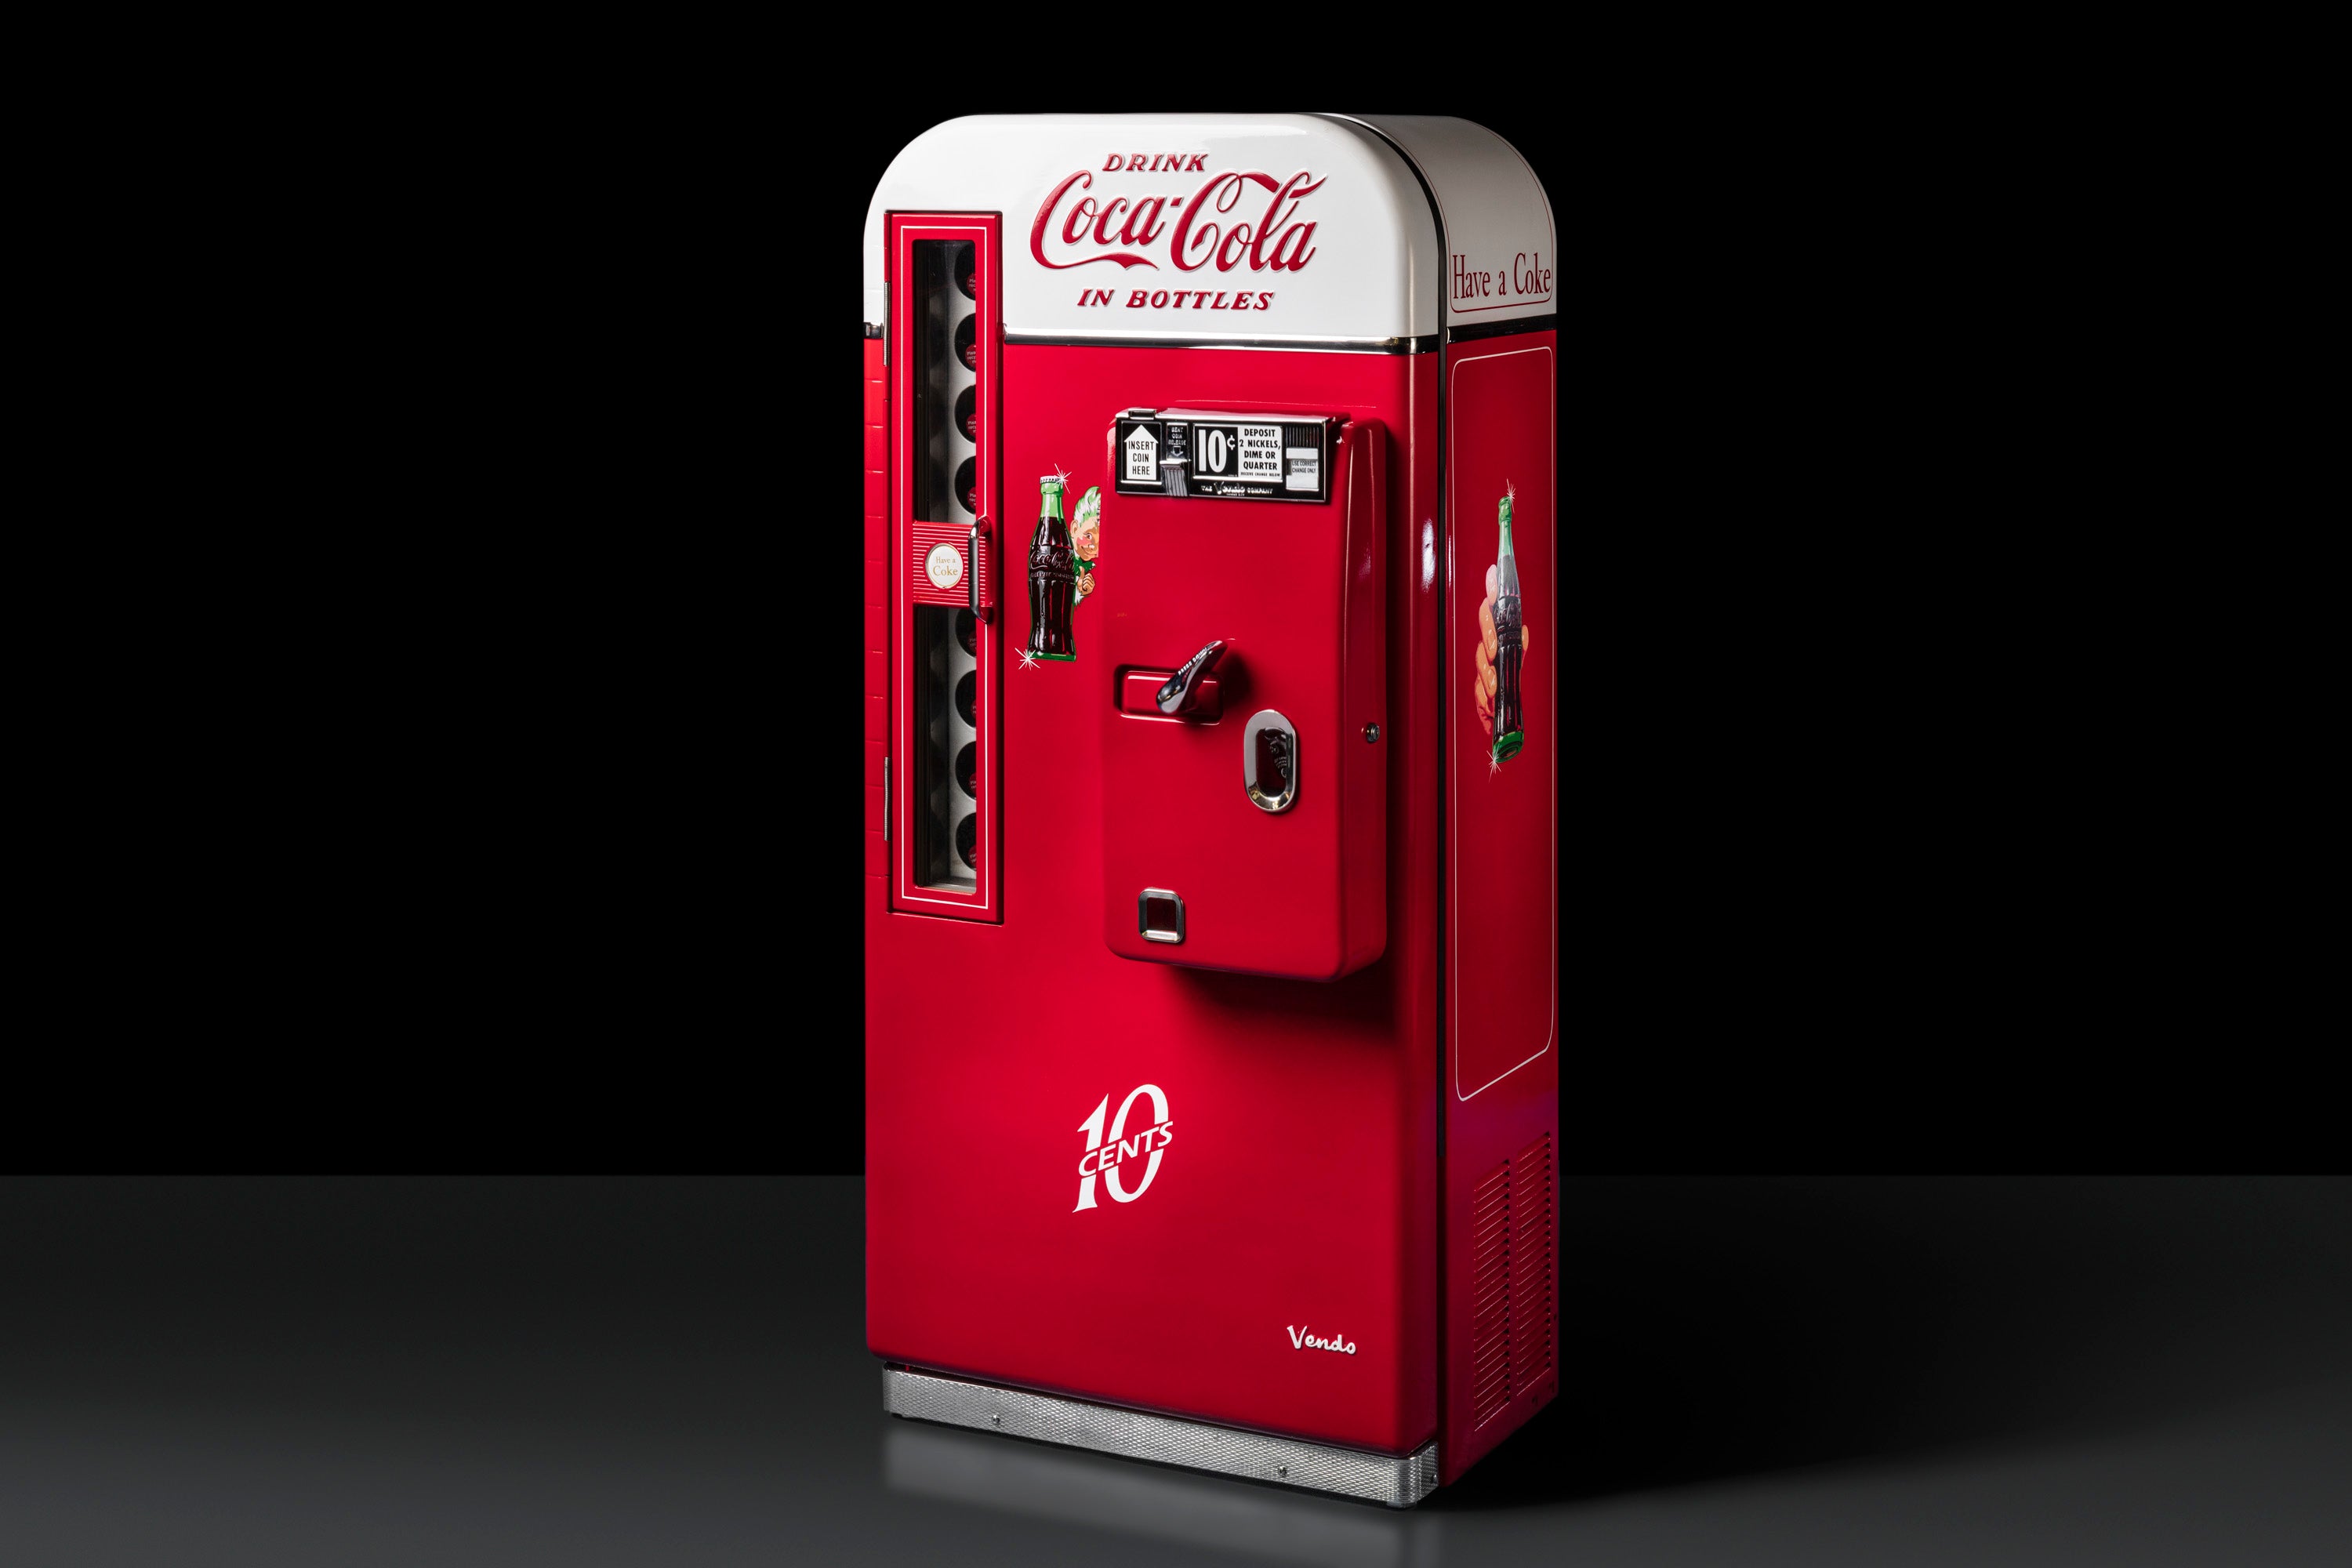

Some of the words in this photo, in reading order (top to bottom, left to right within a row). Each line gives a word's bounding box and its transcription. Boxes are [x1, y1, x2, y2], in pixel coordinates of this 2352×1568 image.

[1102, 153, 1208, 172] DRINK
[1030, 169, 1327, 271] Coca-Cola
[1453, 255, 1490, 299] Have
[1498, 270, 1507, 296] a
[1514, 252, 1551, 295] Coke
[1077, 289, 1115, 307] IN
[1126, 289, 1274, 311] BOTTLES
[1244, 428, 1276, 437] DEPOSIT
[1128, 441, 1154, 450] INSERT
[1248, 439, 1280, 450] NICKELS,
[1132, 452, 1149, 463] COIN
[1244, 450, 1262, 459] DIME
[1132, 466, 1150, 475] HERE
[1243, 461, 1277, 470] QUARTER
[933, 565, 958, 576] Coke
[1073, 1083, 1169, 1214] 10
[1078, 1121, 1174, 1177] CENTS
[1287, 1325, 1357, 1355] Vendo
